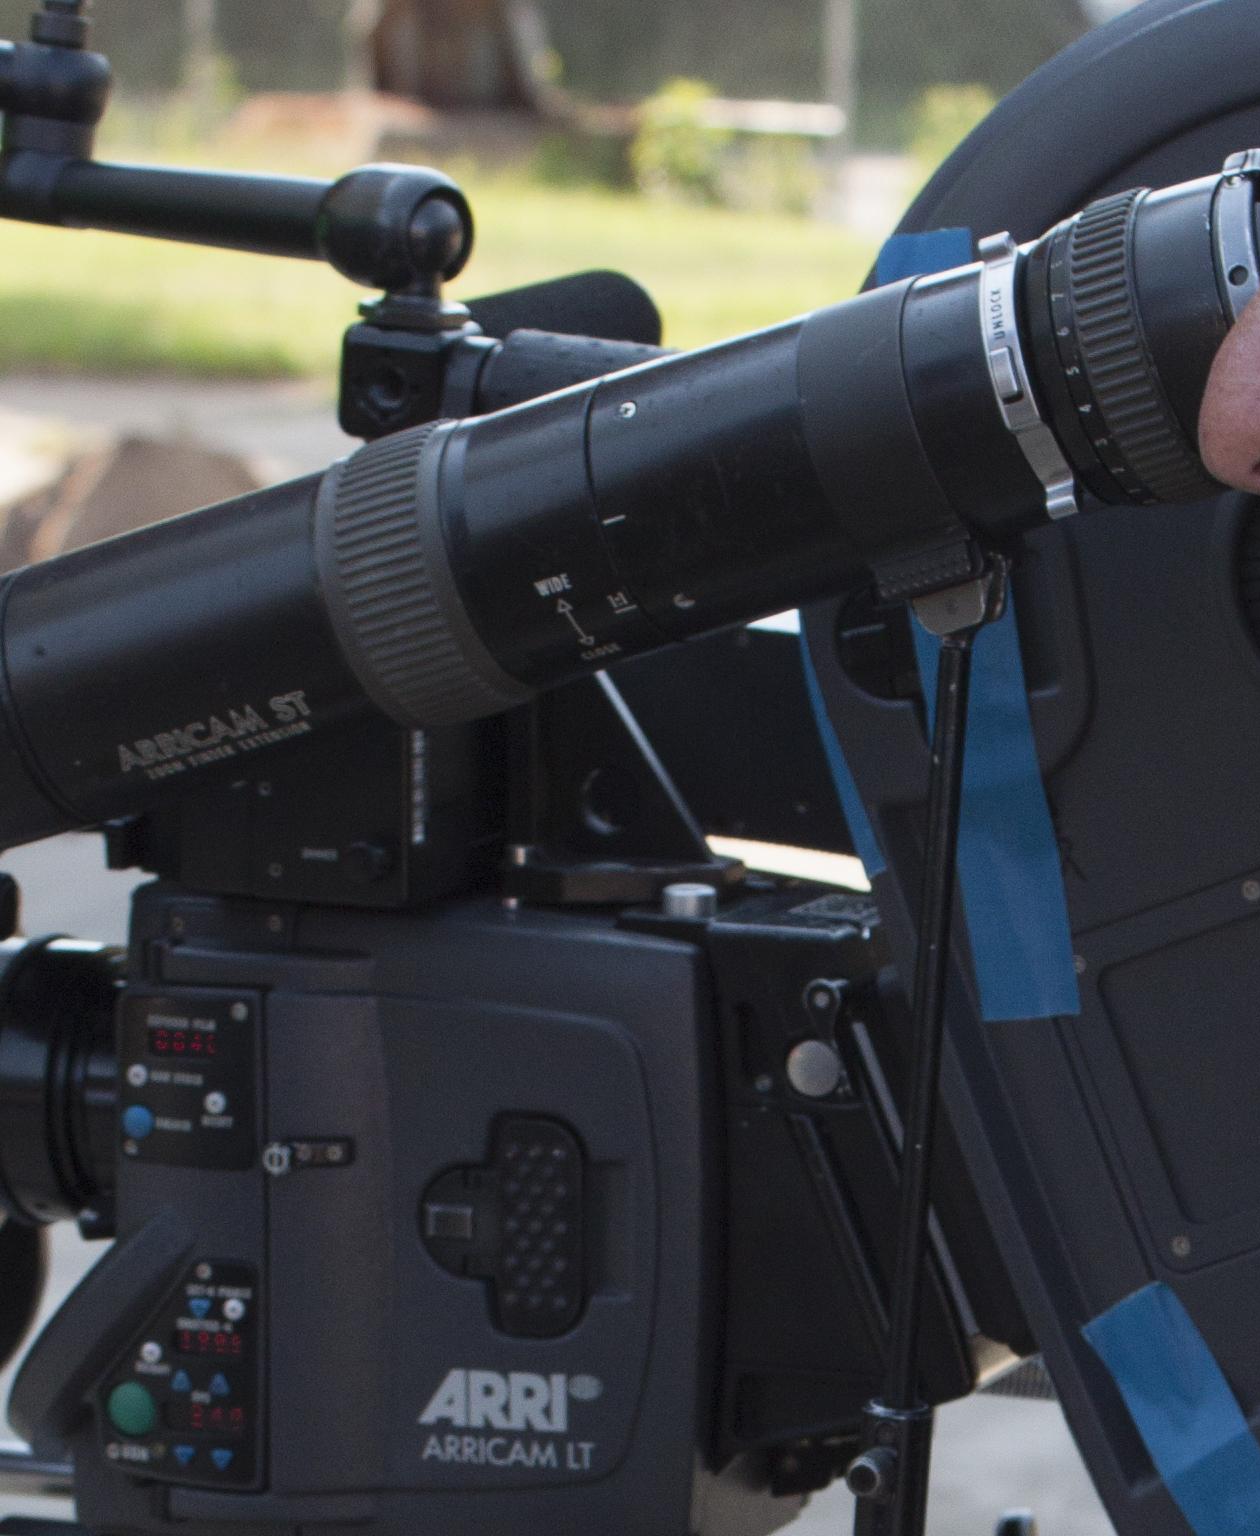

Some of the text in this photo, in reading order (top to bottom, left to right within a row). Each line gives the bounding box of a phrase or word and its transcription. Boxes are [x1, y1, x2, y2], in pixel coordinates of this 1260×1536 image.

[990, 288, 1006, 340] UNLOCK
[533, 573, 572, 597] WIDE
[117, 689, 311, 772] ARRICAM ST
[418, 1368, 568, 1433] ARRI
[421, 1433, 596, 1471] ARRICAM LT
